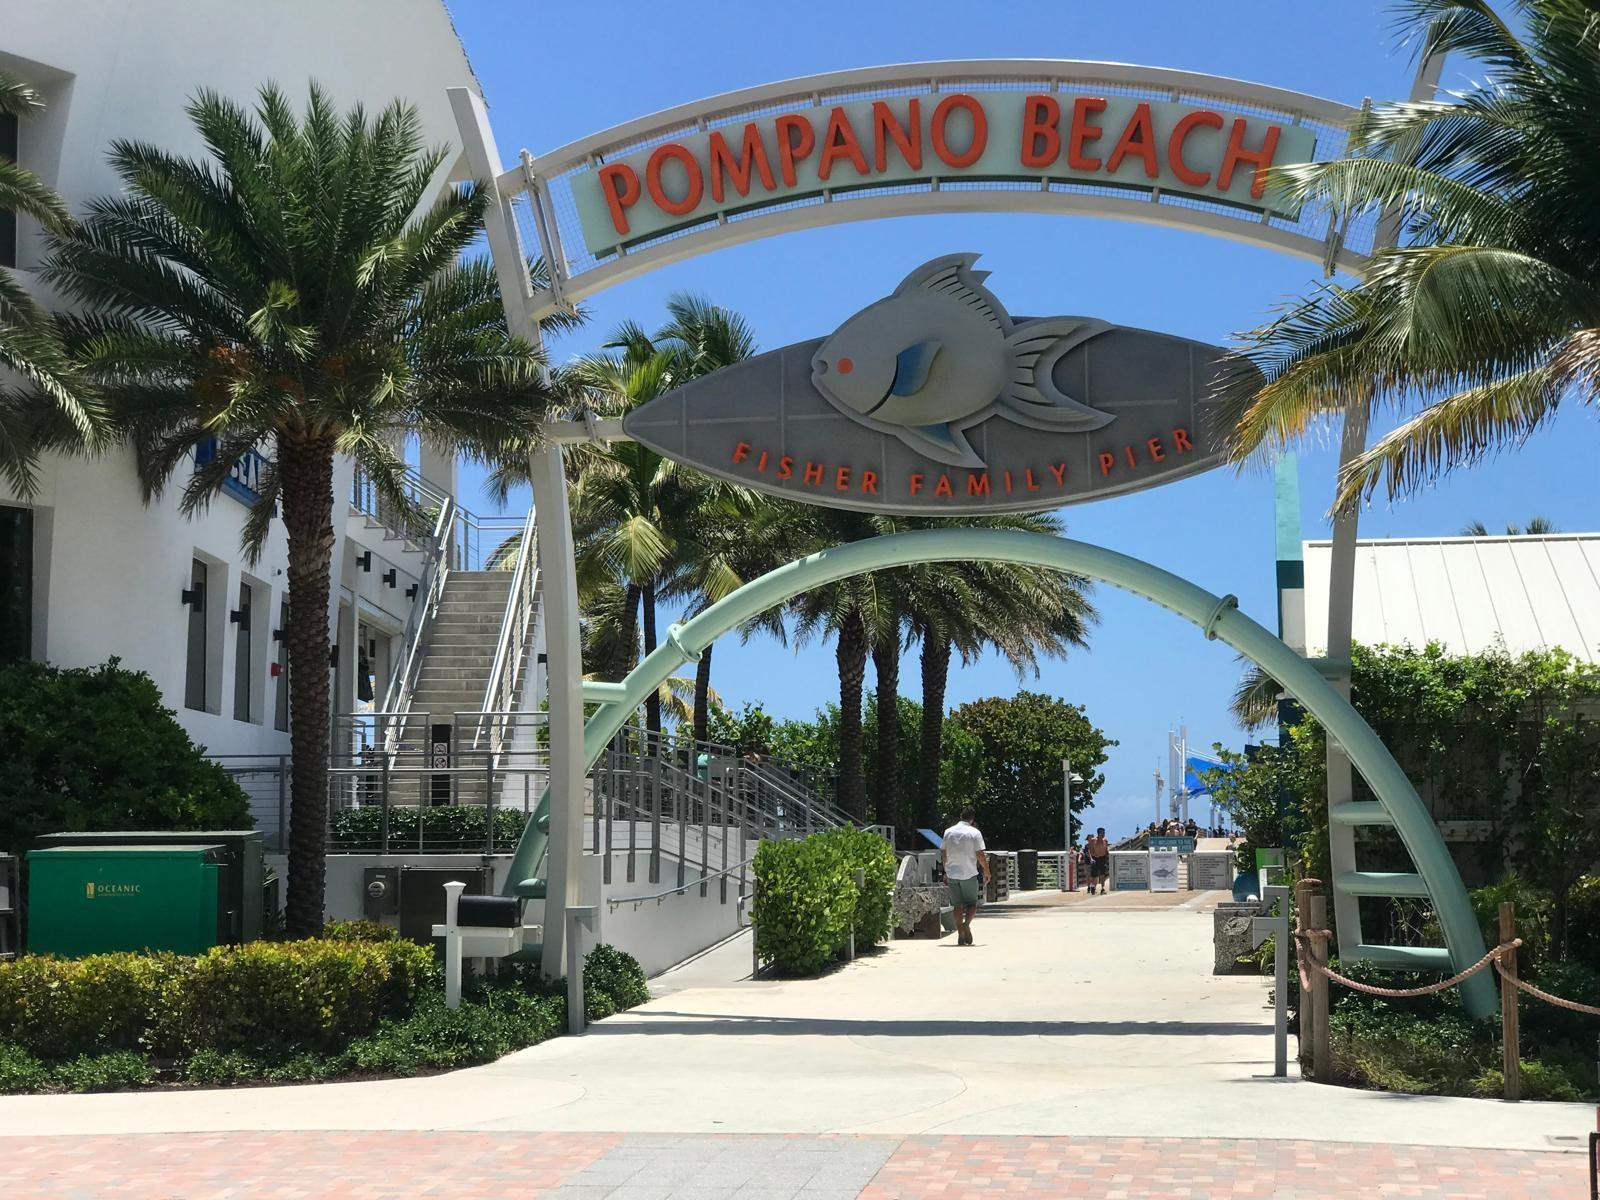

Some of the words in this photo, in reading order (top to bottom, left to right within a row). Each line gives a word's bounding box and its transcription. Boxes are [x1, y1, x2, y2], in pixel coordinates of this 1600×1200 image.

[597, 93, 989, 236] POMPANO
[1020, 94, 1282, 200] BEACH
[731, 442, 879, 496] FISHER
[909, 463, 1068, 498] FAMILY
[1099, 427, 1194, 476] PIER
[97, 884, 141, 893] OCEANIC
